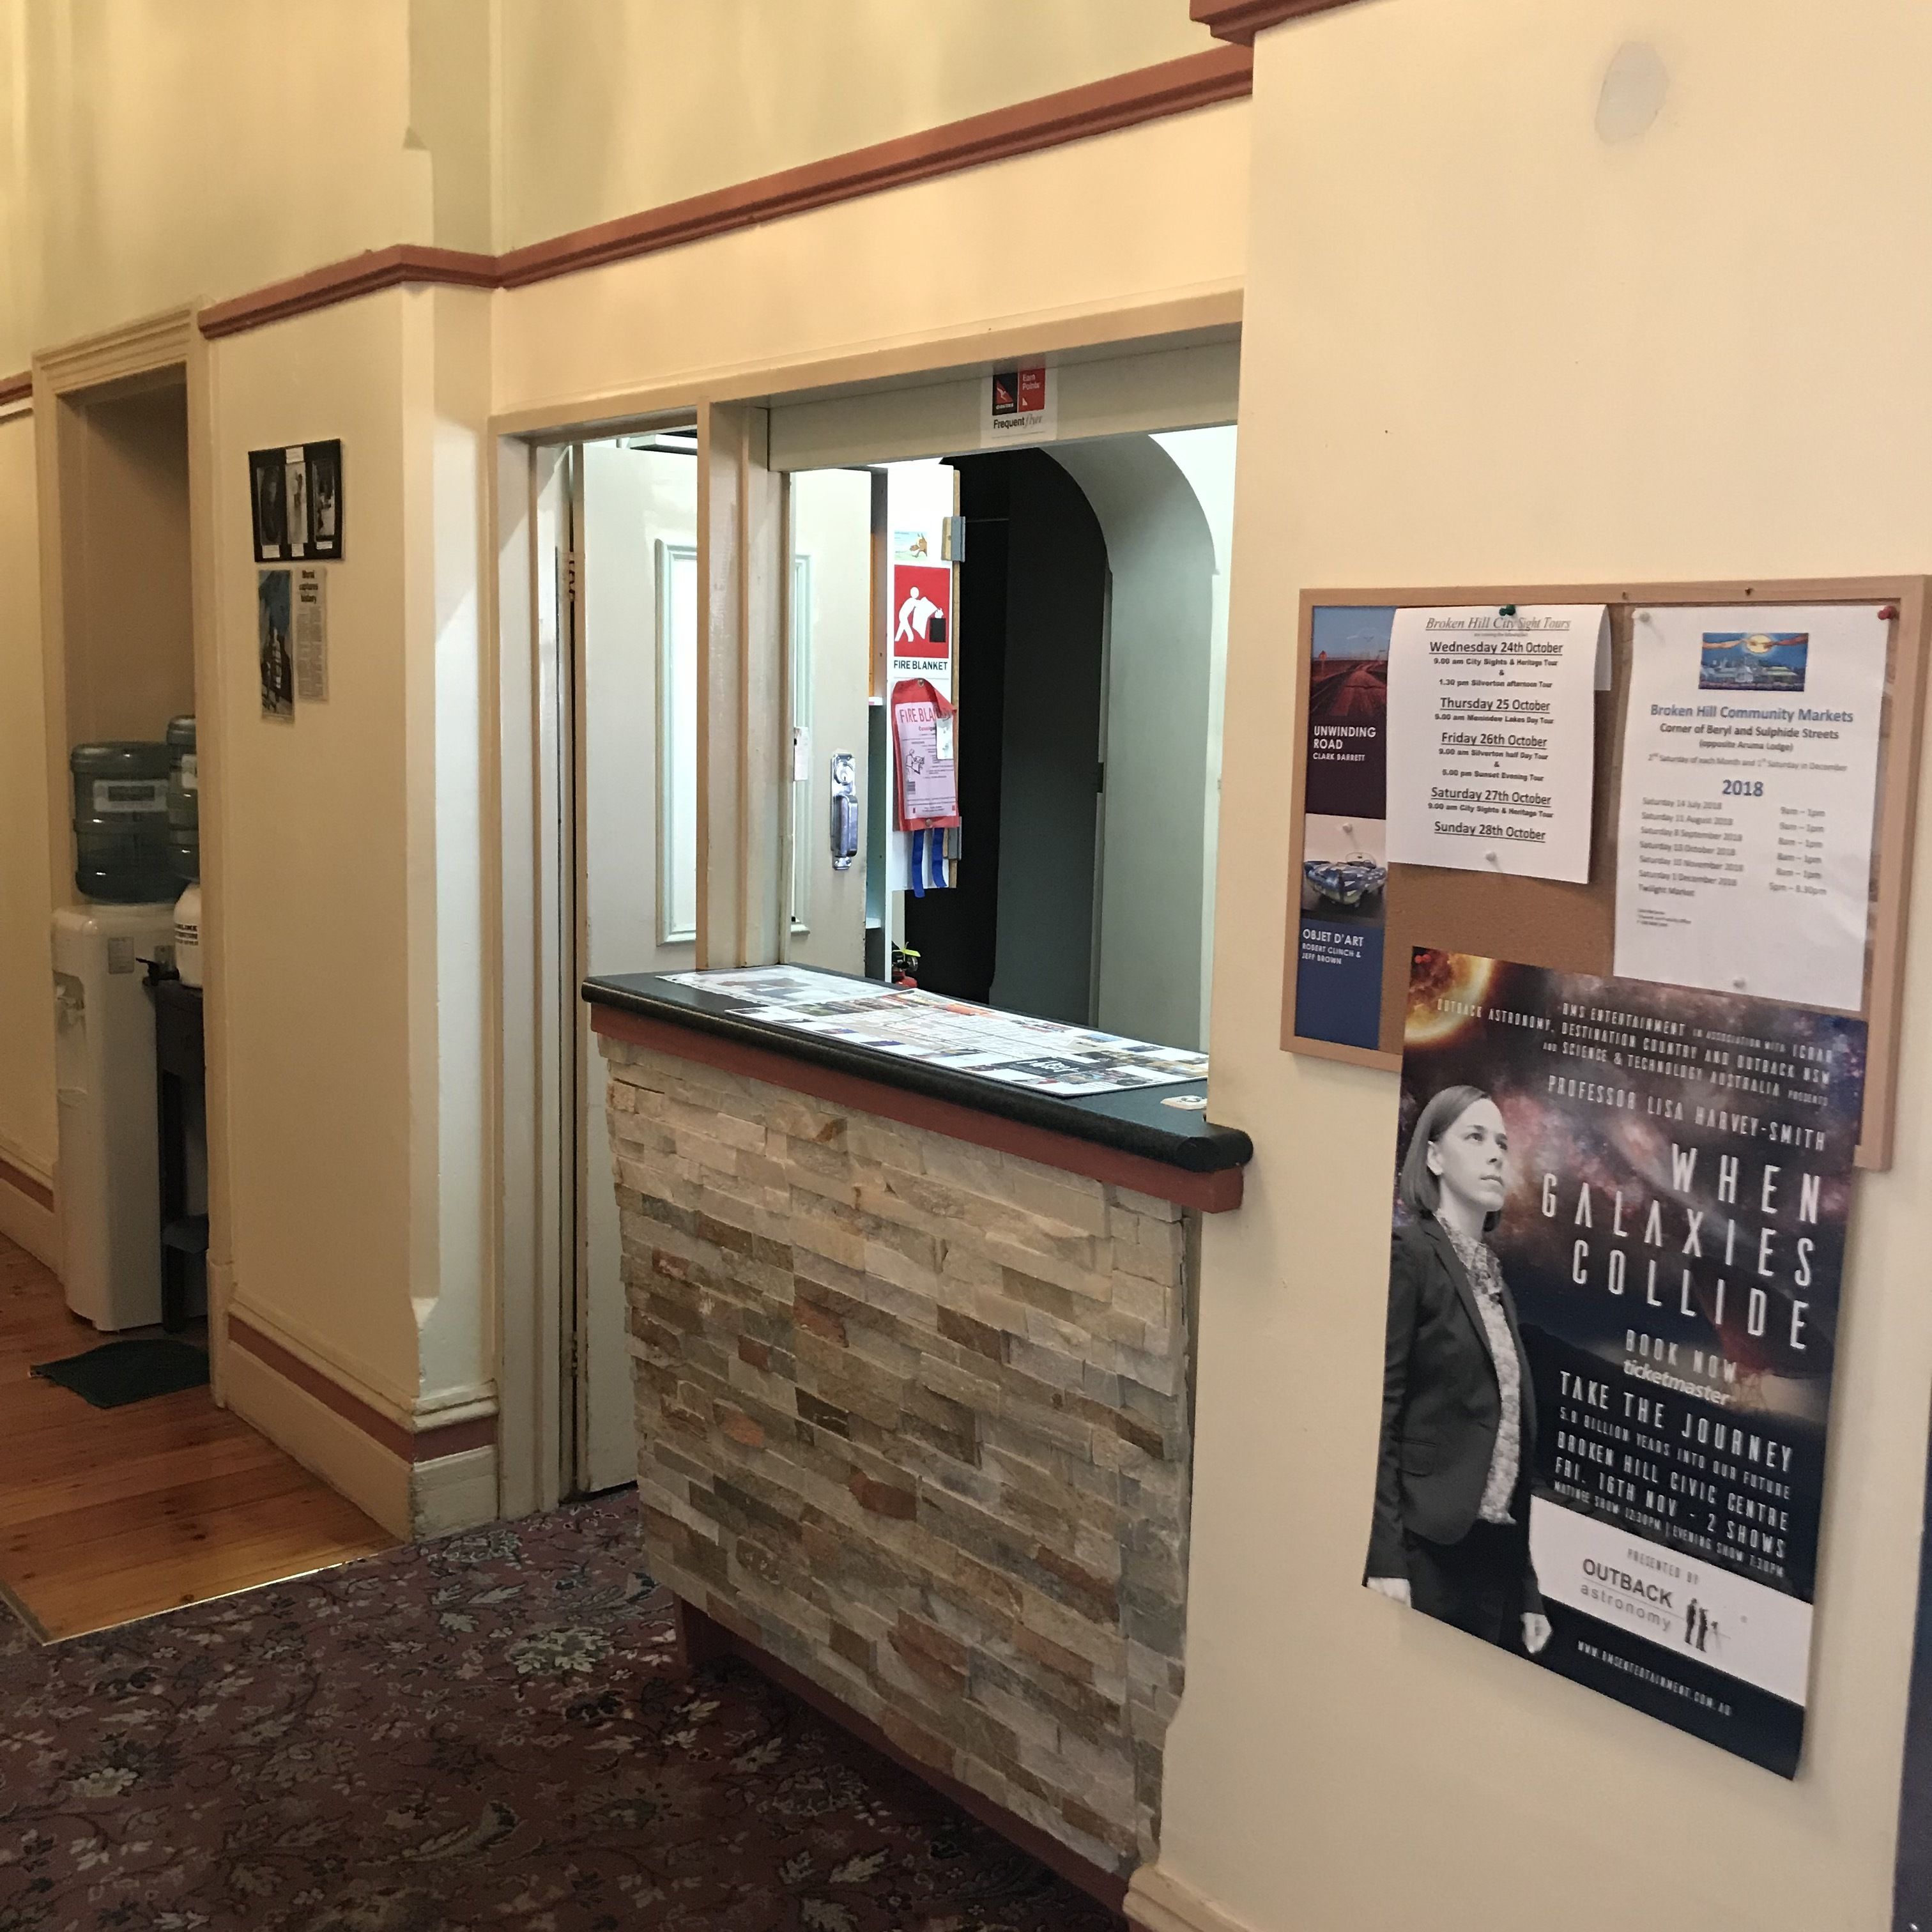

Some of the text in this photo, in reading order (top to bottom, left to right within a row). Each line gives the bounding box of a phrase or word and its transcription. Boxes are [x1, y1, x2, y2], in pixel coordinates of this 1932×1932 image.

[1426, 617, 1464, 629] Broken
[1469, 617, 1491, 629] Hill
[1543, 617, 1572, 629] Tours
[1430, 641, 1563, 654] Wednesday 24th October
[893, 660, 947, 670] FIRE BLANKET
[1440, 698, 1550, 711] Thursday 25 October
[1650, 704, 1853, 723] Broken Hill Community Markets
[900, 707, 917, 724] FIRE
[1314, 725, 1376, 737] UNWINDING
[1441, 732, 1547, 747] Friday 26th October
[1660, 723, 1839, 739] Corner of Beryl and Sulphide Streets
[1314, 739, 1343, 749] ROAD
[1431, 786, 1551, 804] Saturday 27th October
[1722, 779, 1764, 797] 2018
[1434, 821, 1545, 839] Sunday 28th October
[1303, 928, 1364, 947] OBJET D'ART
[1302, 942, 1326, 953] ROBERT
[1317, 954, 1342, 964] BROWN
[1561, 1022, 1636, 1048] DESTINATION
[1705, 1049, 1729, 1066] AND
[1563, 1041, 1607, 1062] SCIENCE
[1613, 1052, 1623, 1066] &
[1548, 1075, 1825, 1151] PROFESSOR LISA HARVEY-SMITH
[1671, 1143, 1821, 1224] WHEN
[1542, 1172, 1815, 1287] GALAXIES
[1572, 1239, 1809, 1349] COLLIDE
[1626, 1329, 1737, 1383] BOOK NOW
[1623, 1359, 1731, 1406] ticketmaster
[1560, 1370, 1793, 1472] TAKE THE JOURNEY
[1636, 1432, 1671, 1457] YEARS
[1676, 1448, 1706, 1469] INTO
[1743, 1471, 1790, 1500] FUTURE
[1557, 1430, 1788, 1531] BROKEN HILL CIVIC CENTRE
[1600, 1471, 1636, 1502] 16TH
[1646, 1490, 1678, 1517] NOV
[1707, 1513, 1716, 1533] 2
[1726, 1520, 1786, 1559] SHOWS
[1583, 1558, 1673, 1609] OUTBACK
[1580, 1583, 1671, 1632] astronomy
